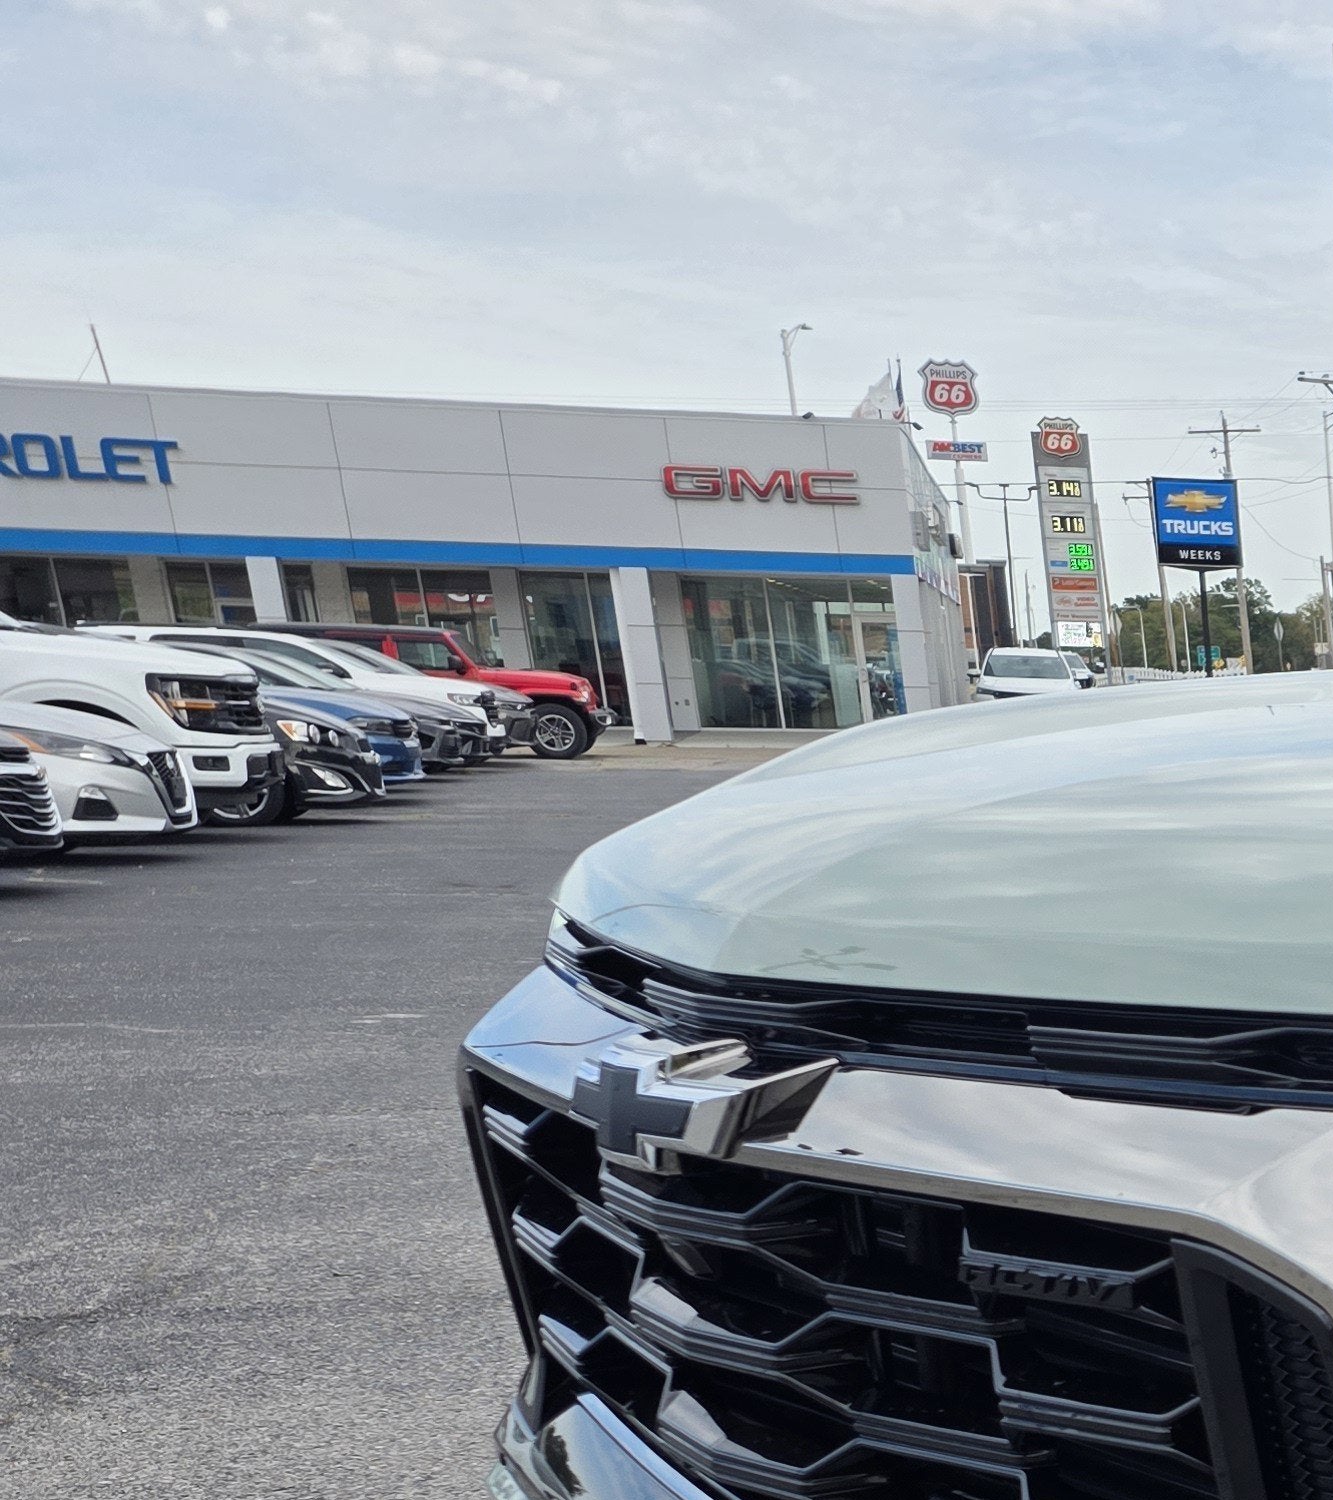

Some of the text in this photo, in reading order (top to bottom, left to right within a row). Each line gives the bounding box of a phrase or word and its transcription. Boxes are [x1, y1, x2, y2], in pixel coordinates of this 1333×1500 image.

[930, 368, 967, 380] PHILLIPS
[934, 383, 967, 404] 66
[1044, 422, 1073, 431] PHILLIPS
[1047, 433, 1074, 450] 66
[661, 464, 860, 505] GMC
[1162, 519, 1234, 536] TRUCKS
[1179, 549, 1222, 560] WEEKS
[959, 1262, 1121, 1305] ACTIV
